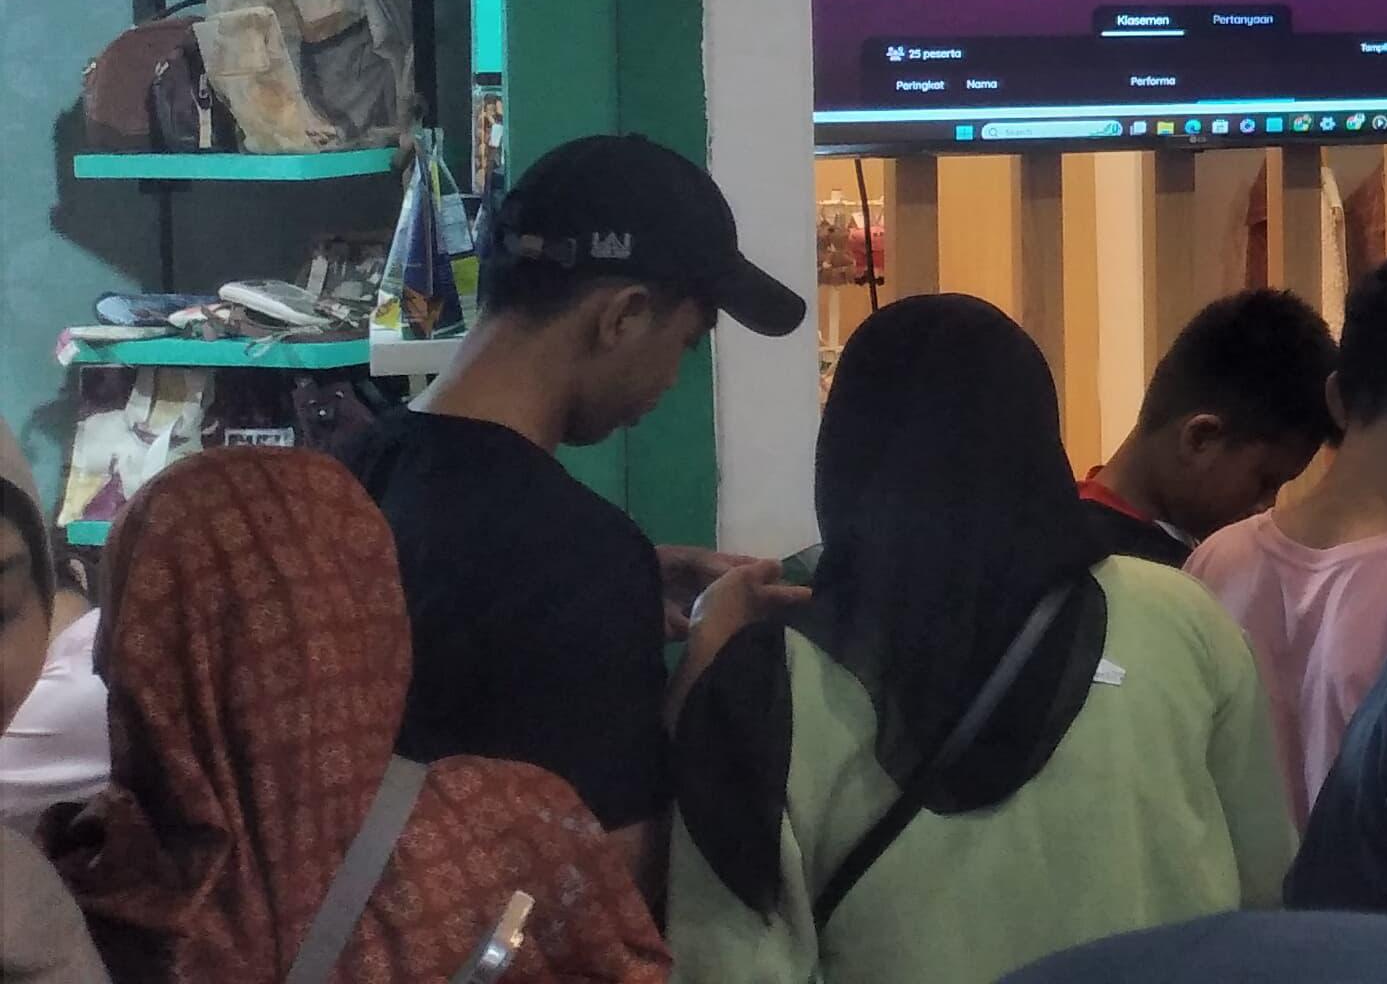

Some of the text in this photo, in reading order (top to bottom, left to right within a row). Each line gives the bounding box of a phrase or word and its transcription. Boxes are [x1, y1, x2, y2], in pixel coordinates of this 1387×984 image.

[1213, 13, 1273, 27] Pertanyaan
[908, 48, 962, 60] 25 peserta
[896, 75, 1176, 92] Peringkat Nama Performa
